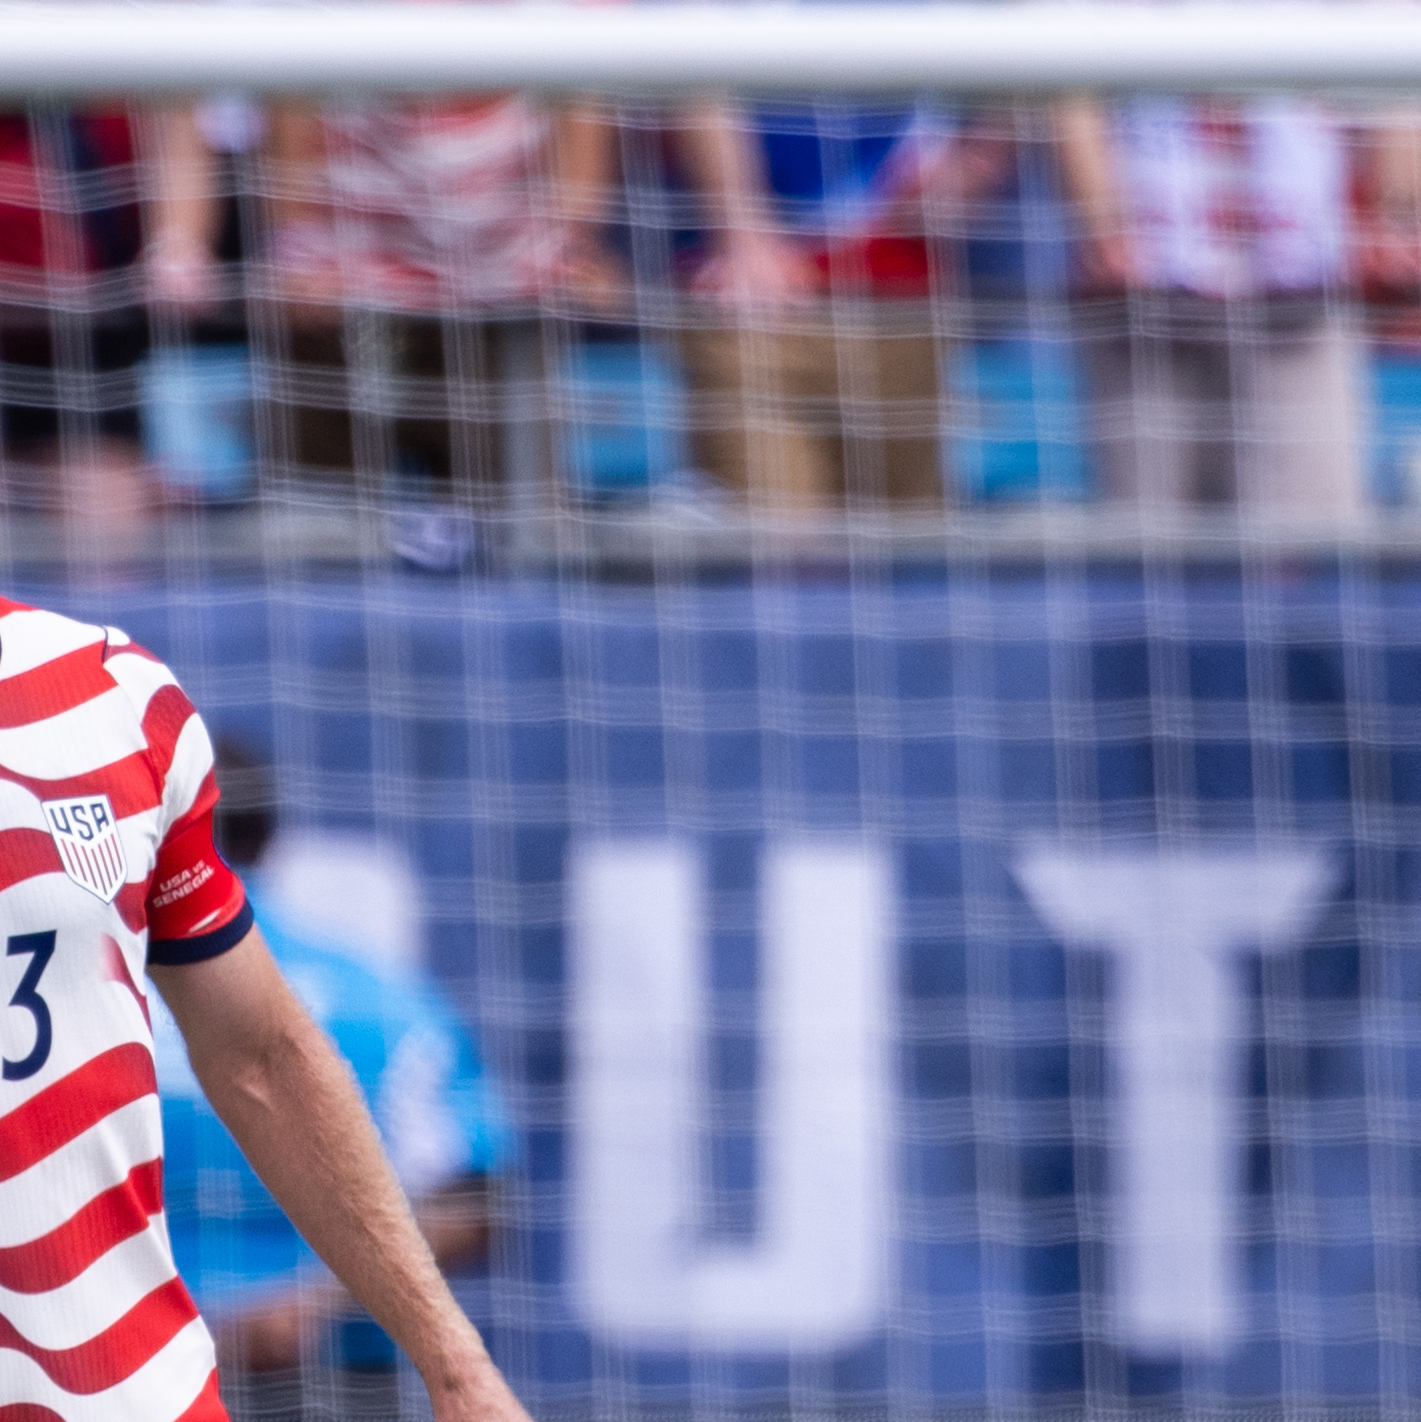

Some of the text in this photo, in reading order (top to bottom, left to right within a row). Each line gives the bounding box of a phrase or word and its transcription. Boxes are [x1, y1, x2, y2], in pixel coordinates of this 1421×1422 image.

[49, 802, 110, 841] USA
[152, 865, 215, 909] SENEGAL
[159, 868, 191, 894] USA
